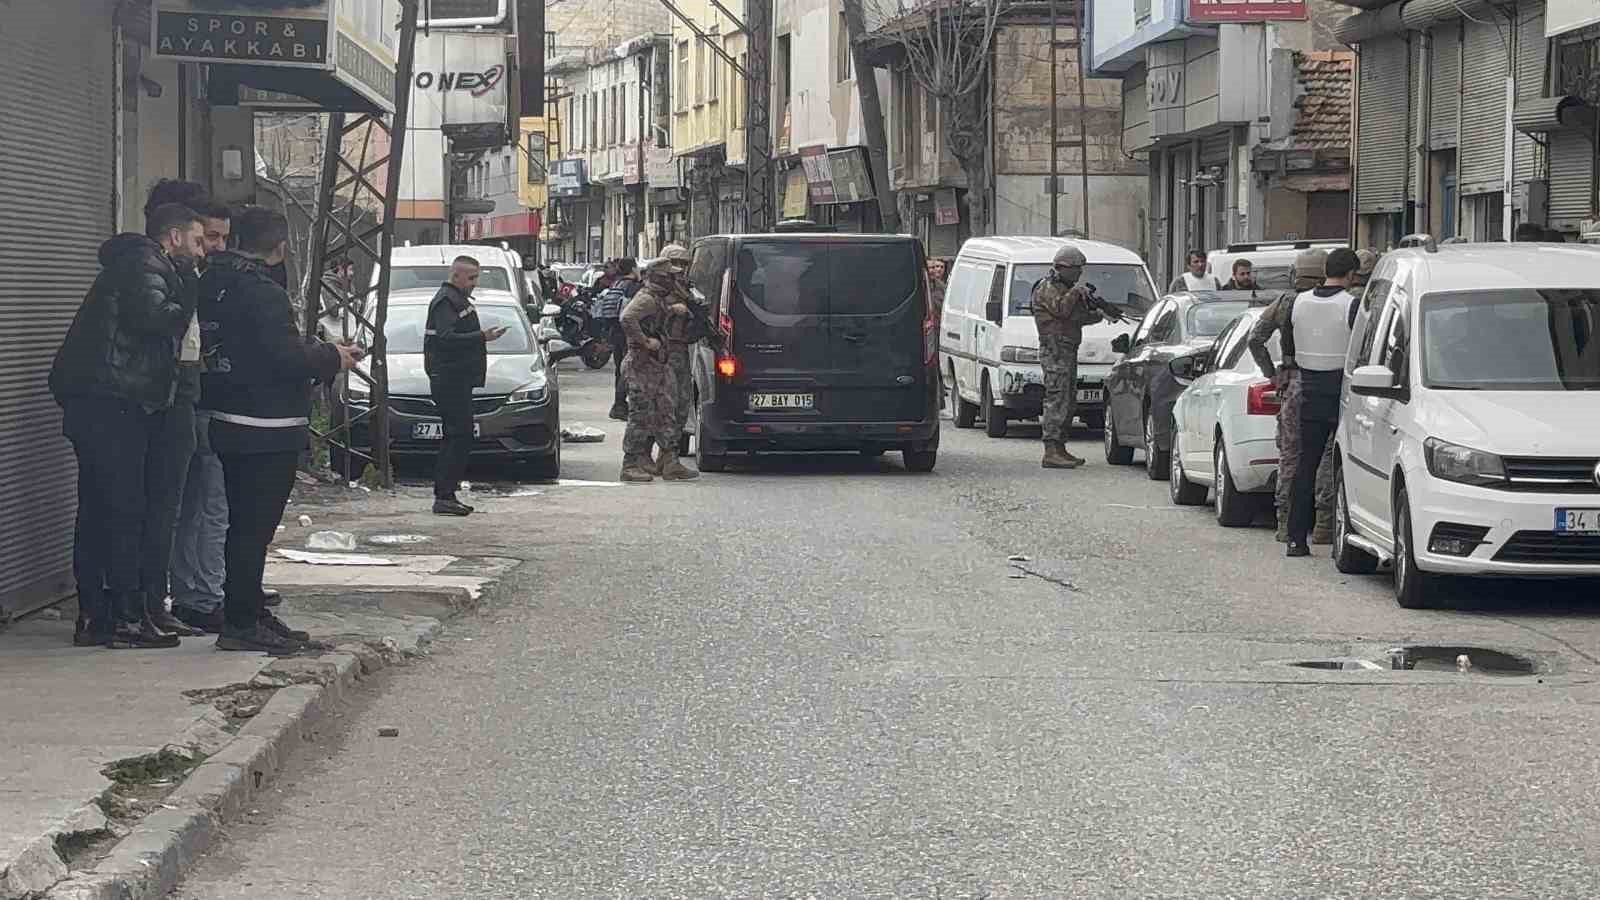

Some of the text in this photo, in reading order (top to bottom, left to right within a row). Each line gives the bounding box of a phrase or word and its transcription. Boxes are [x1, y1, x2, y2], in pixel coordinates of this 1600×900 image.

[187, 18, 297, 38] SPOR &
[160, 37, 321, 59] AYAKKABI
[754, 395, 812, 406] 27 BAY 015
[418, 424, 431, 435] 27
[1568, 511, 1586, 530] 34
